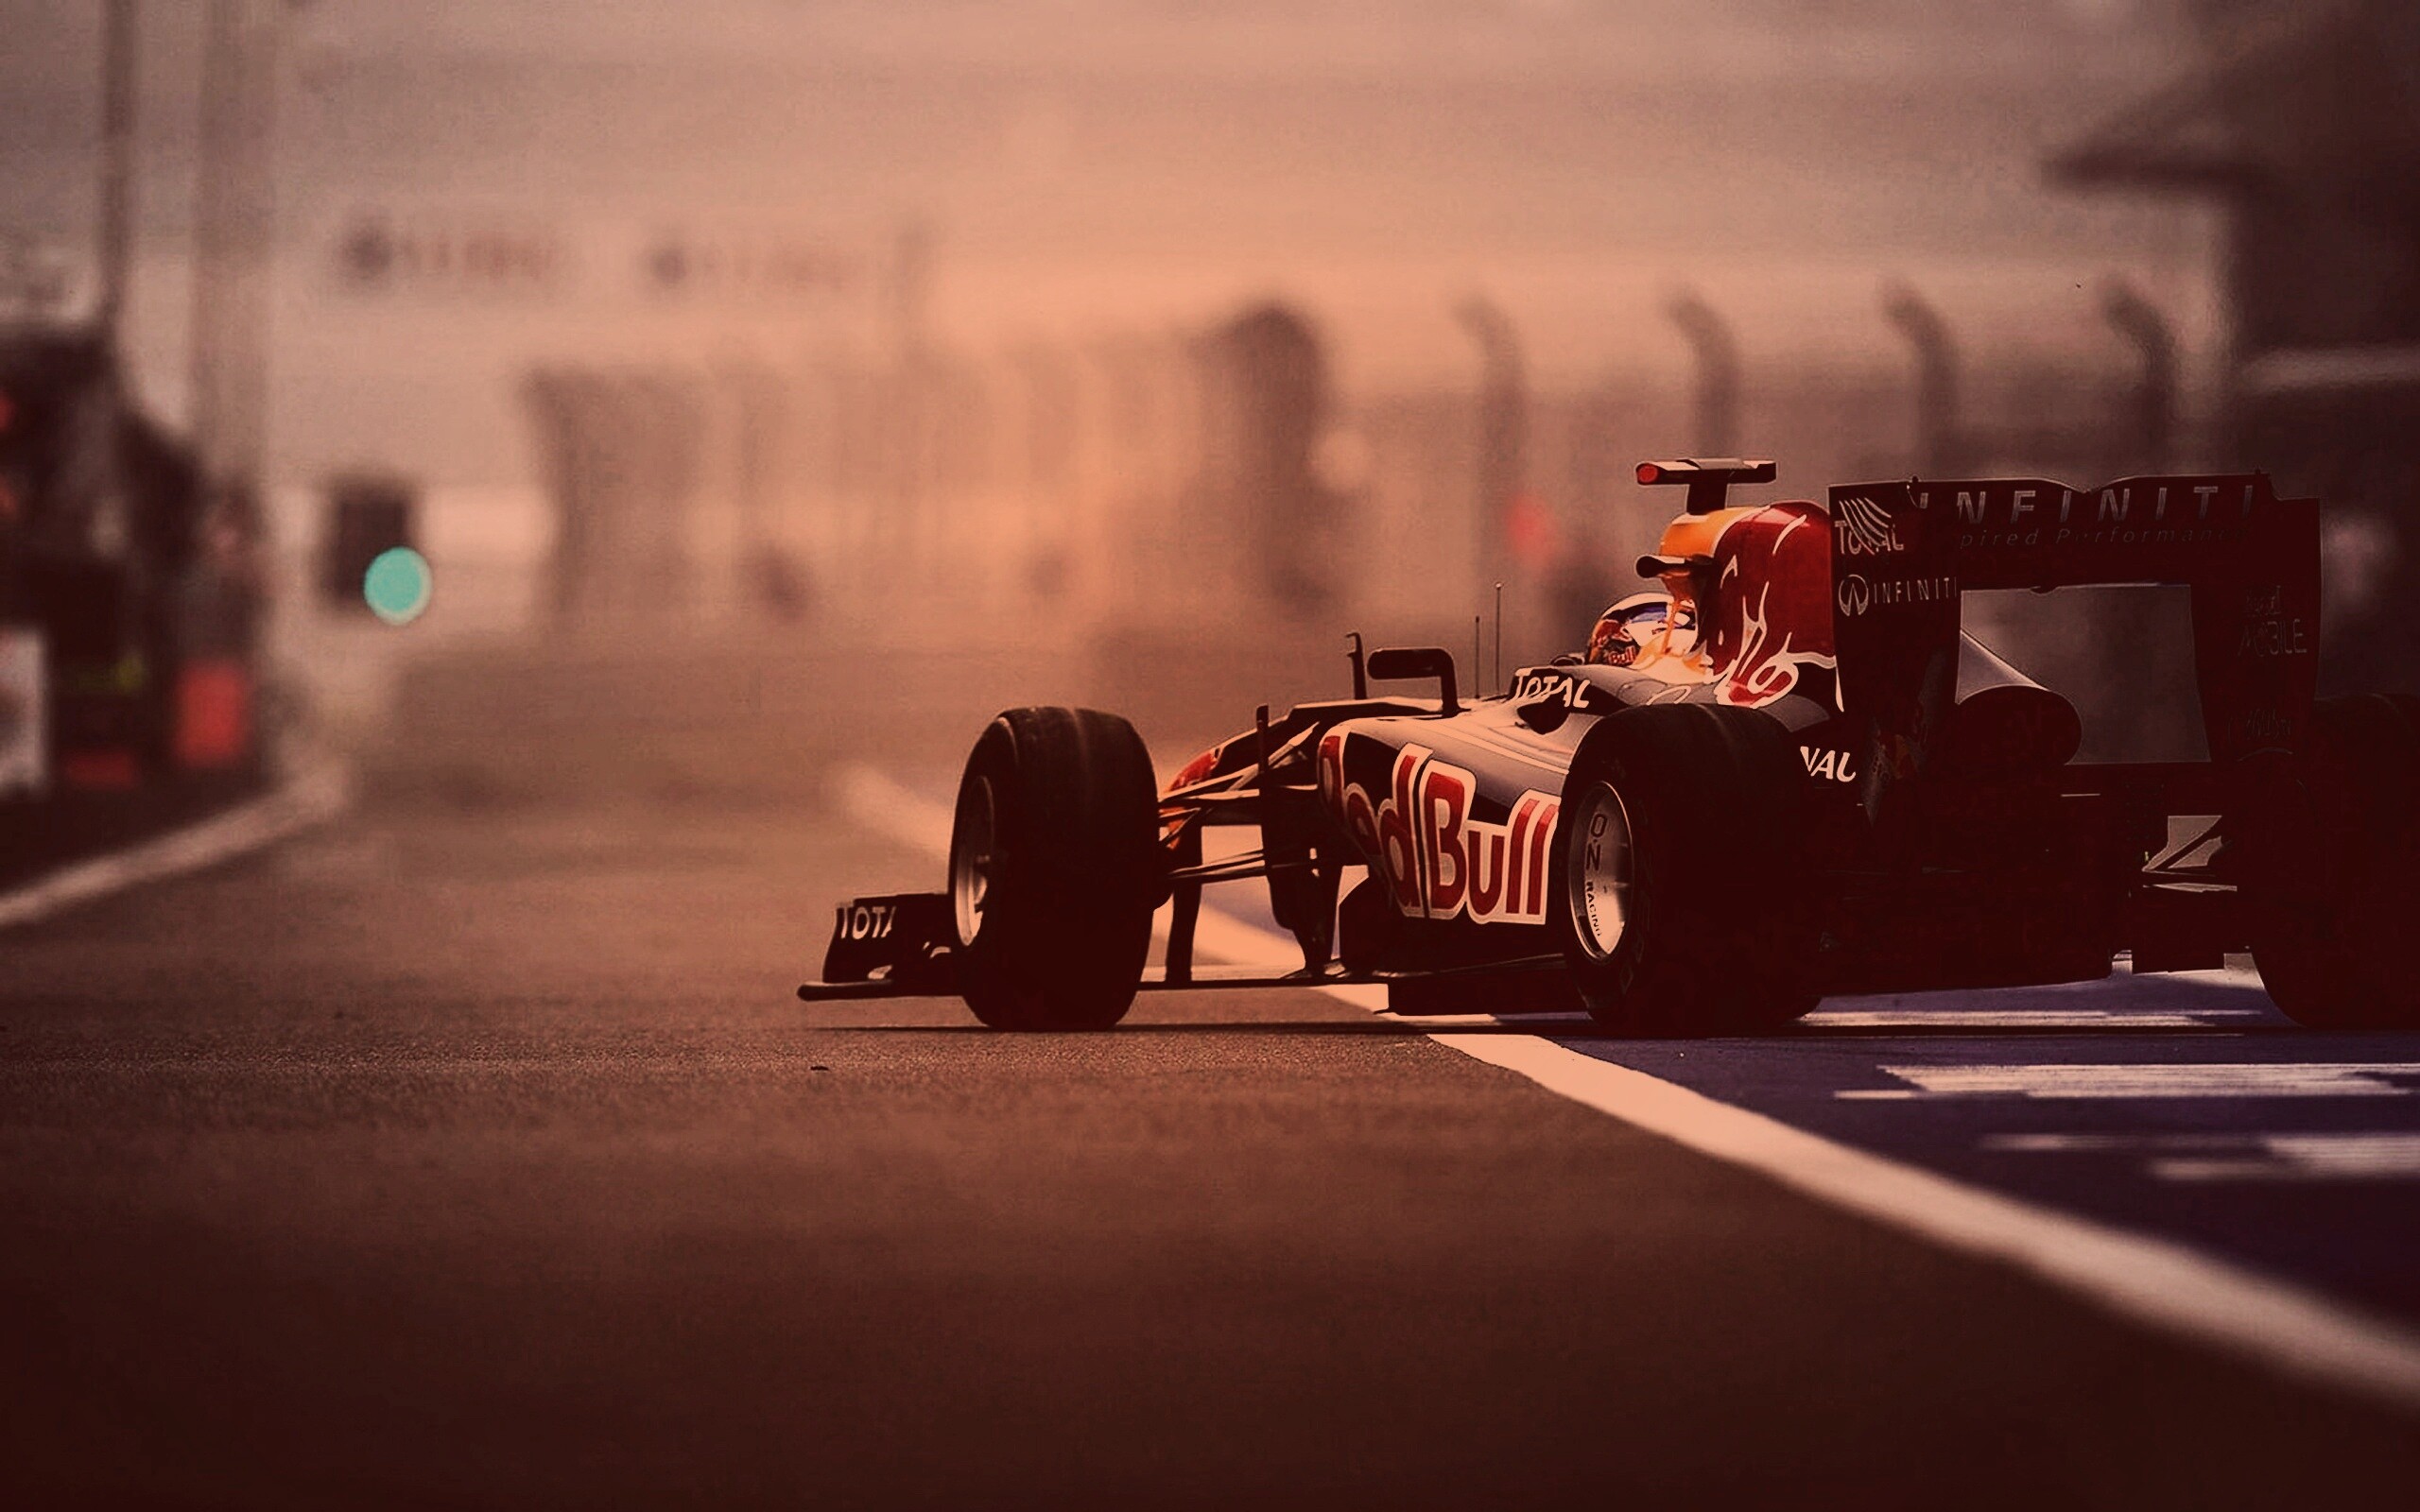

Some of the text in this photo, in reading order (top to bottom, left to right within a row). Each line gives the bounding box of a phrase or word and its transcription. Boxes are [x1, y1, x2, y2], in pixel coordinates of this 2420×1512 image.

[1960, 526, 2040, 549] pired
[1874, 576, 1958, 605] INFINITI
[1514, 667, 1591, 709] TOTAL
[1423, 765, 1561, 919] Bull
